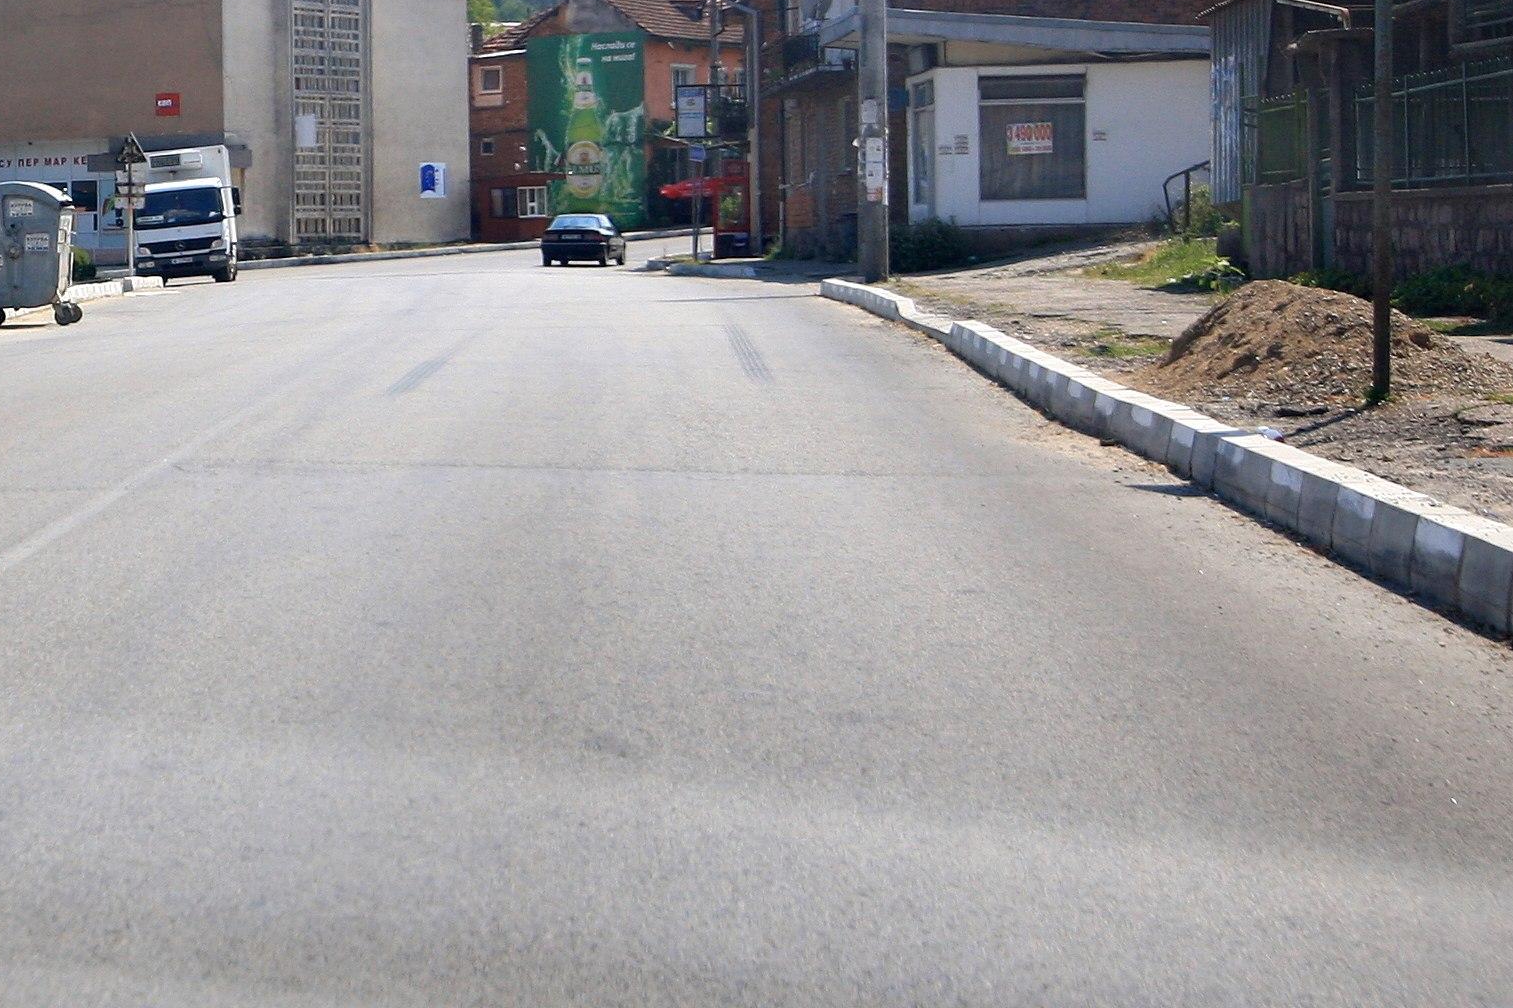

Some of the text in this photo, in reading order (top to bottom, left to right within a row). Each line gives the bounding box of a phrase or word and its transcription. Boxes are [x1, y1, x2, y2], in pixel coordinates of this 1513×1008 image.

[18, 157, 39, 167] ПЕР
[44, 157, 67, 166] МАР
[73, 156, 88, 165] КЕ
